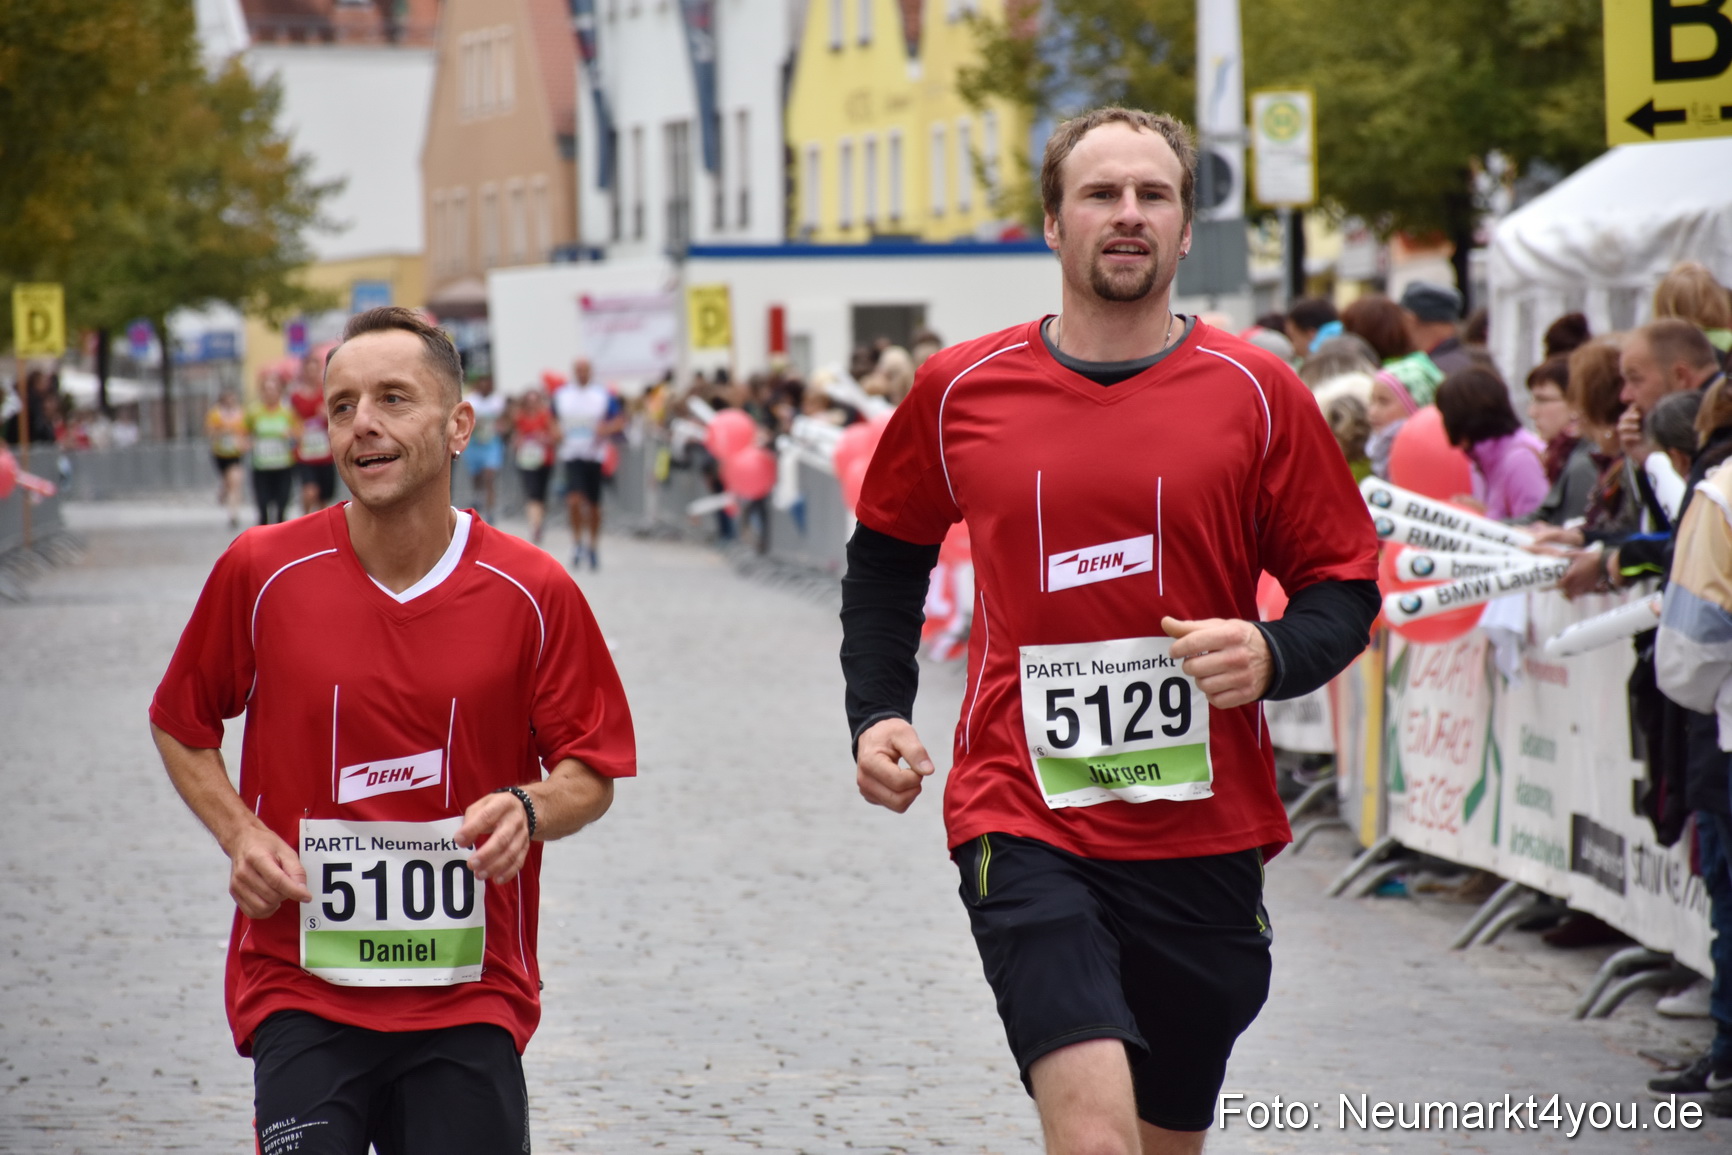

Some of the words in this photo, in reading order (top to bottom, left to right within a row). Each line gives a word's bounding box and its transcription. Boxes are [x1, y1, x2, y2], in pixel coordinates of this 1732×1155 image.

[1651, 0, 1732, 84] B
[27, 308, 52, 342] D
[1077, 552, 1124, 575] DEHN
[1436, 579, 1491, 606] BMW
[1026, 662, 1087, 679] PARTL
[1092, 653, 1176, 675] Neumarkt
[1046, 676, 1192, 750] 5129
[366, 766, 415, 787] DEHN
[1089, 762, 1161, 785] Jürgen
[304, 837, 366, 852] PARTL
[371, 837, 458, 852] Neumarkt
[321, 859, 475, 922] 5100
[359, 938, 436, 962] Daniel
